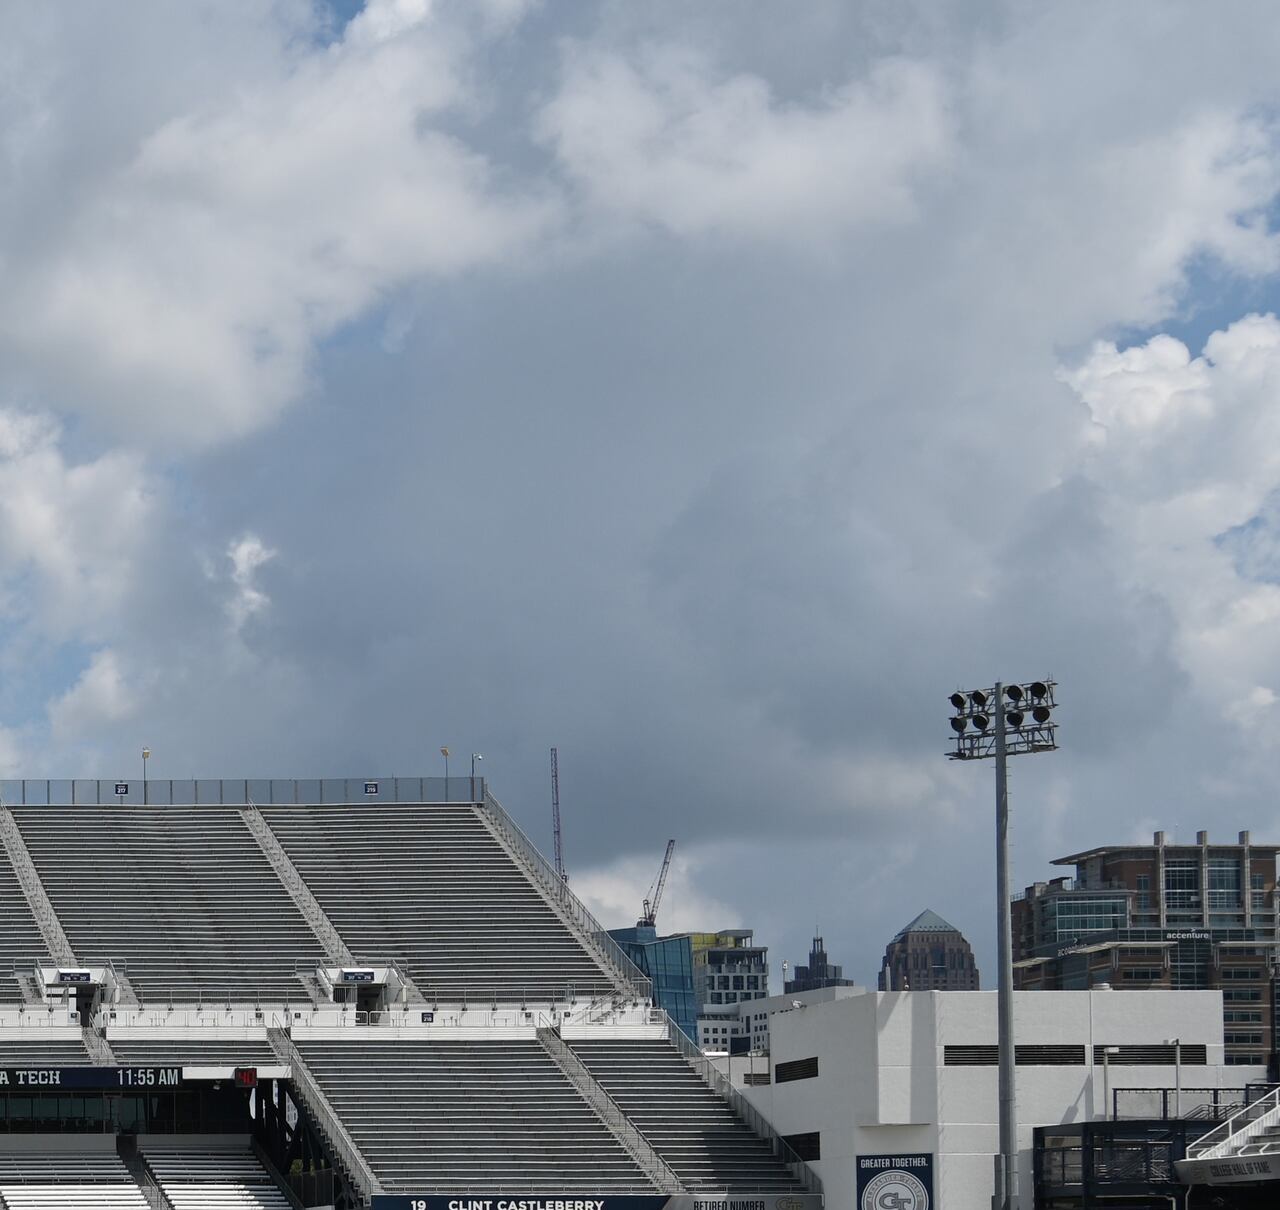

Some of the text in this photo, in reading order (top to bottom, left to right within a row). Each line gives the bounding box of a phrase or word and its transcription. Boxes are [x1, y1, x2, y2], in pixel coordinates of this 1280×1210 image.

[16, 1071, 61, 1085] TECH
[117, 1069, 178, 1085] 11:55 AM
[860, 1158, 890, 1168] GREATER
[1233, 1163, 1247, 1176] HALL
